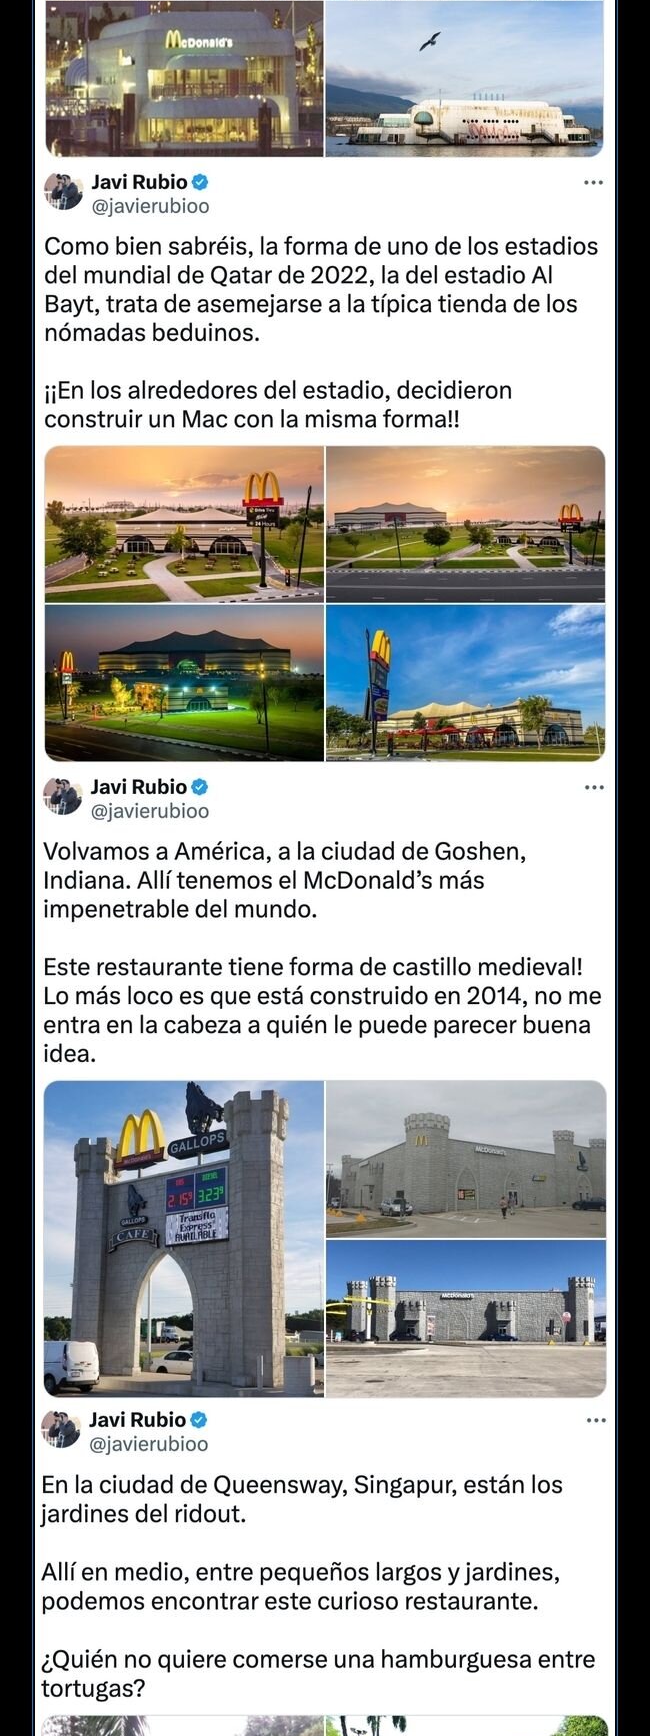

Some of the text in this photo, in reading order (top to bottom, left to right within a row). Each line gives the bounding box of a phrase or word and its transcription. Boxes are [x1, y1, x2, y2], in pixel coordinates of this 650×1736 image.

[165, 29, 233, 48] McDonald's
[170, 1132, 225, 1154] GALLOPS
[116, 1229, 149, 1242] CAFE
